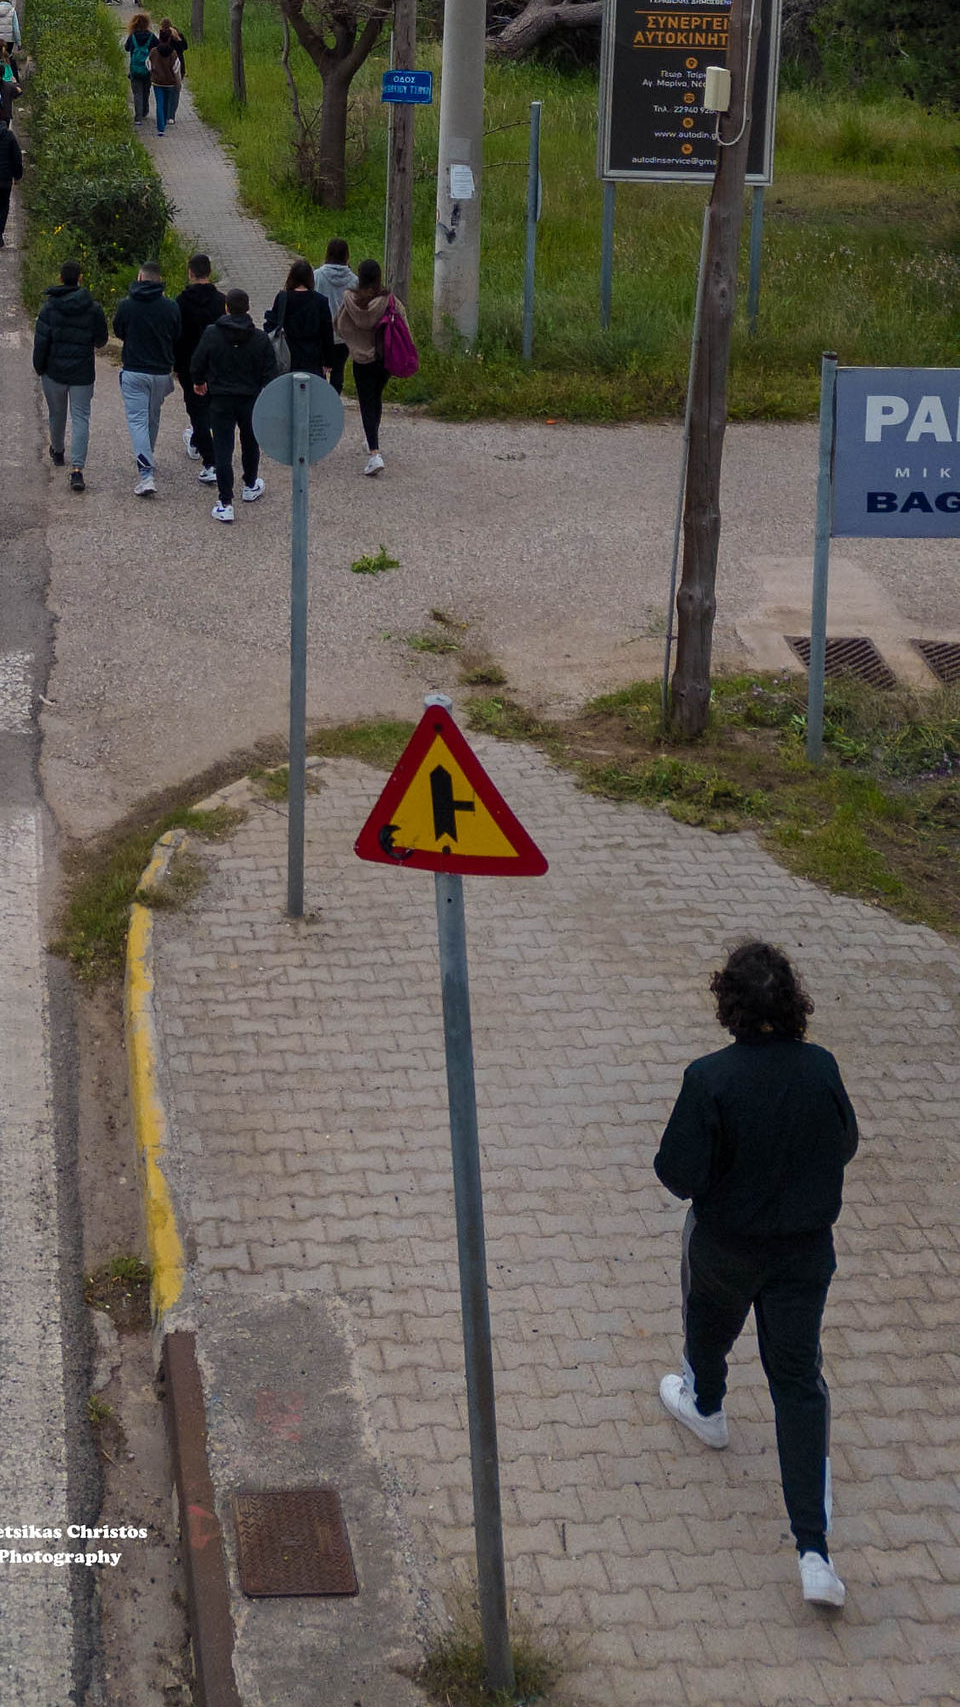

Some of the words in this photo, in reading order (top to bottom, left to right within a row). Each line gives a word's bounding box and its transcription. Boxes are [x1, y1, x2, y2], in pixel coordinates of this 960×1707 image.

[646, 15, 728, 30] ΣΥΝΕΡΓΕΙ
[633, 30, 729, 45] ΑΥΤΟΚΙΝΗΤ
[393, 75, 415, 83] ΟΔΟΣ
[654, 130, 718, 140] www.autodin.g
[631, 156, 717, 167] autodinservice@gma
[864, 395, 960, 443] PA
